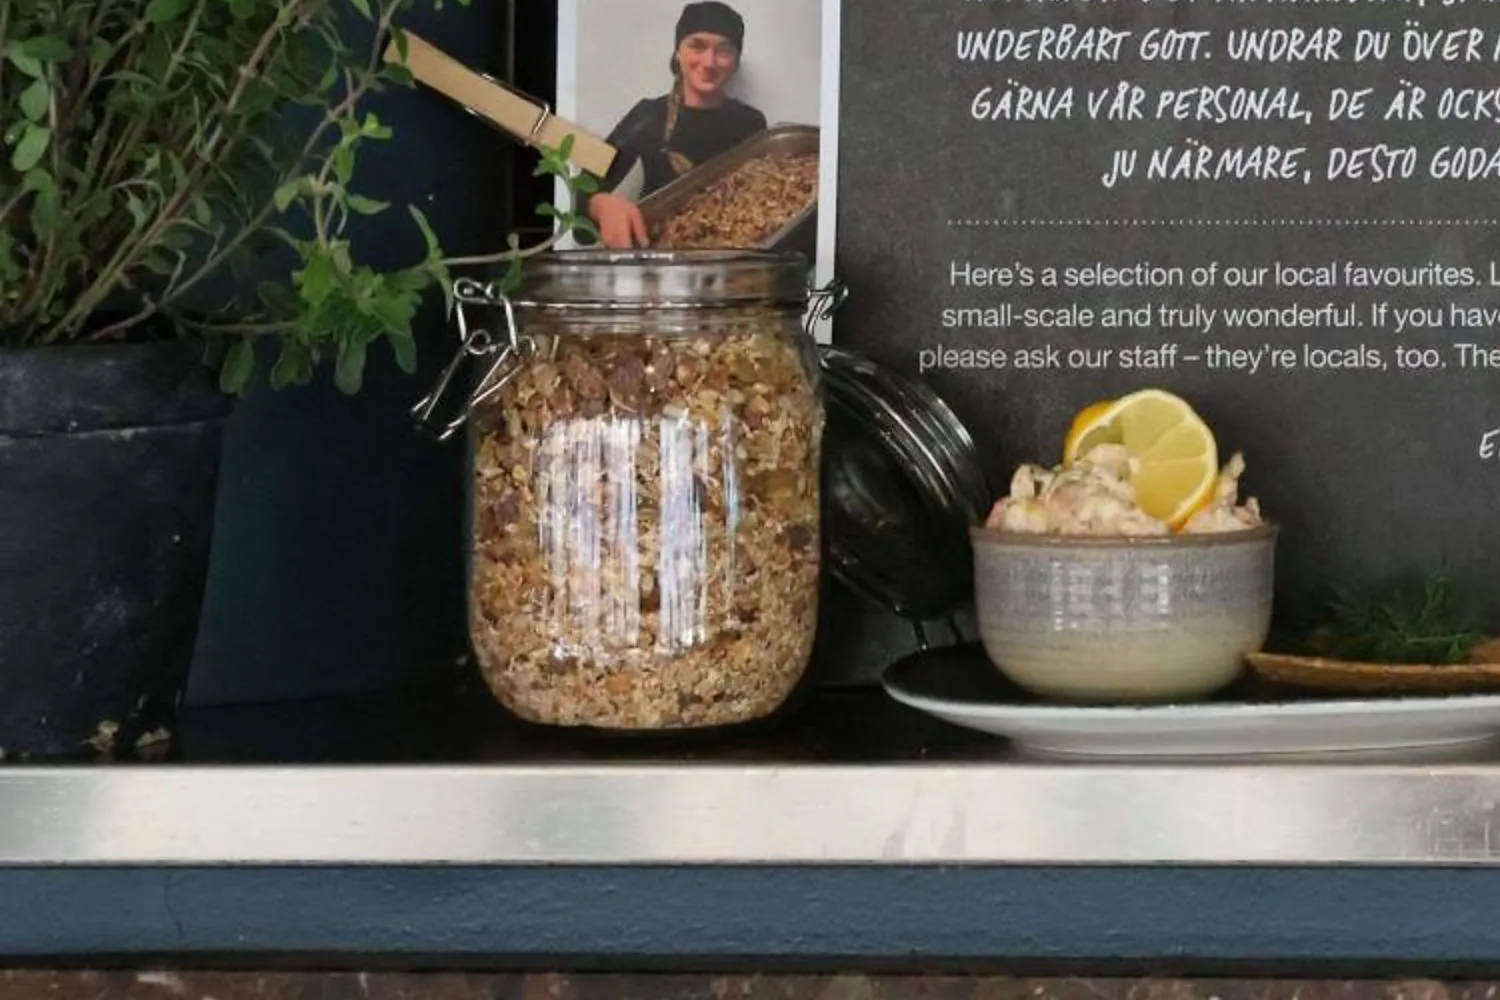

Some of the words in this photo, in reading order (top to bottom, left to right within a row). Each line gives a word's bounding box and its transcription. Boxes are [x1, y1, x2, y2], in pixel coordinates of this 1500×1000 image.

[956, 24, 1132, 62] UNDERBART
[1140, 28, 1212, 62] GOTT.
[1228, 29, 1344, 62] UNDRAR
[1355, 29, 1389, 62] DU
[1403, 21, 1482, 62] ÖVER
[971, 78, 1073, 121] GÄRNA
[1088, 81, 1144, 120] VÅR
[1156, 86, 1312, 125] PERSONAL,
[1330, 87, 1373, 120] DE
[1385, 79, 1427, 121] ÄR
[1101, 149, 1136, 188] JU
[1147, 139, 1311, 185] NÄRMARE,
[1328, 145, 1417, 183] DESTO
[1041, 267, 1058, 288] a
[1064, 261, 1184, 289] selection
[1191, 261, 1219, 288] of
[1223, 267, 1268, 288] our
[1275, 261, 1338, 288] local
[1344, 261, 1482, 288] favourites.
[941, 303, 1094, 328] small-scale
[1101, 303, 1152, 328] and
[1159, 303, 1216, 333] truly
[1222, 302, 1364, 328] wonderful.
[1371, 303, 1390, 328] If
[1393, 308, 1444, 333] you
[919, 344, 1008, 372] please
[1013, 344, 1061, 369] ask
[1067, 348, 1112, 369] our
[1119, 344, 1178, 369] staff
[1302, 344, 1389, 372] locals,
[1396, 345, 1448, 369] too.
